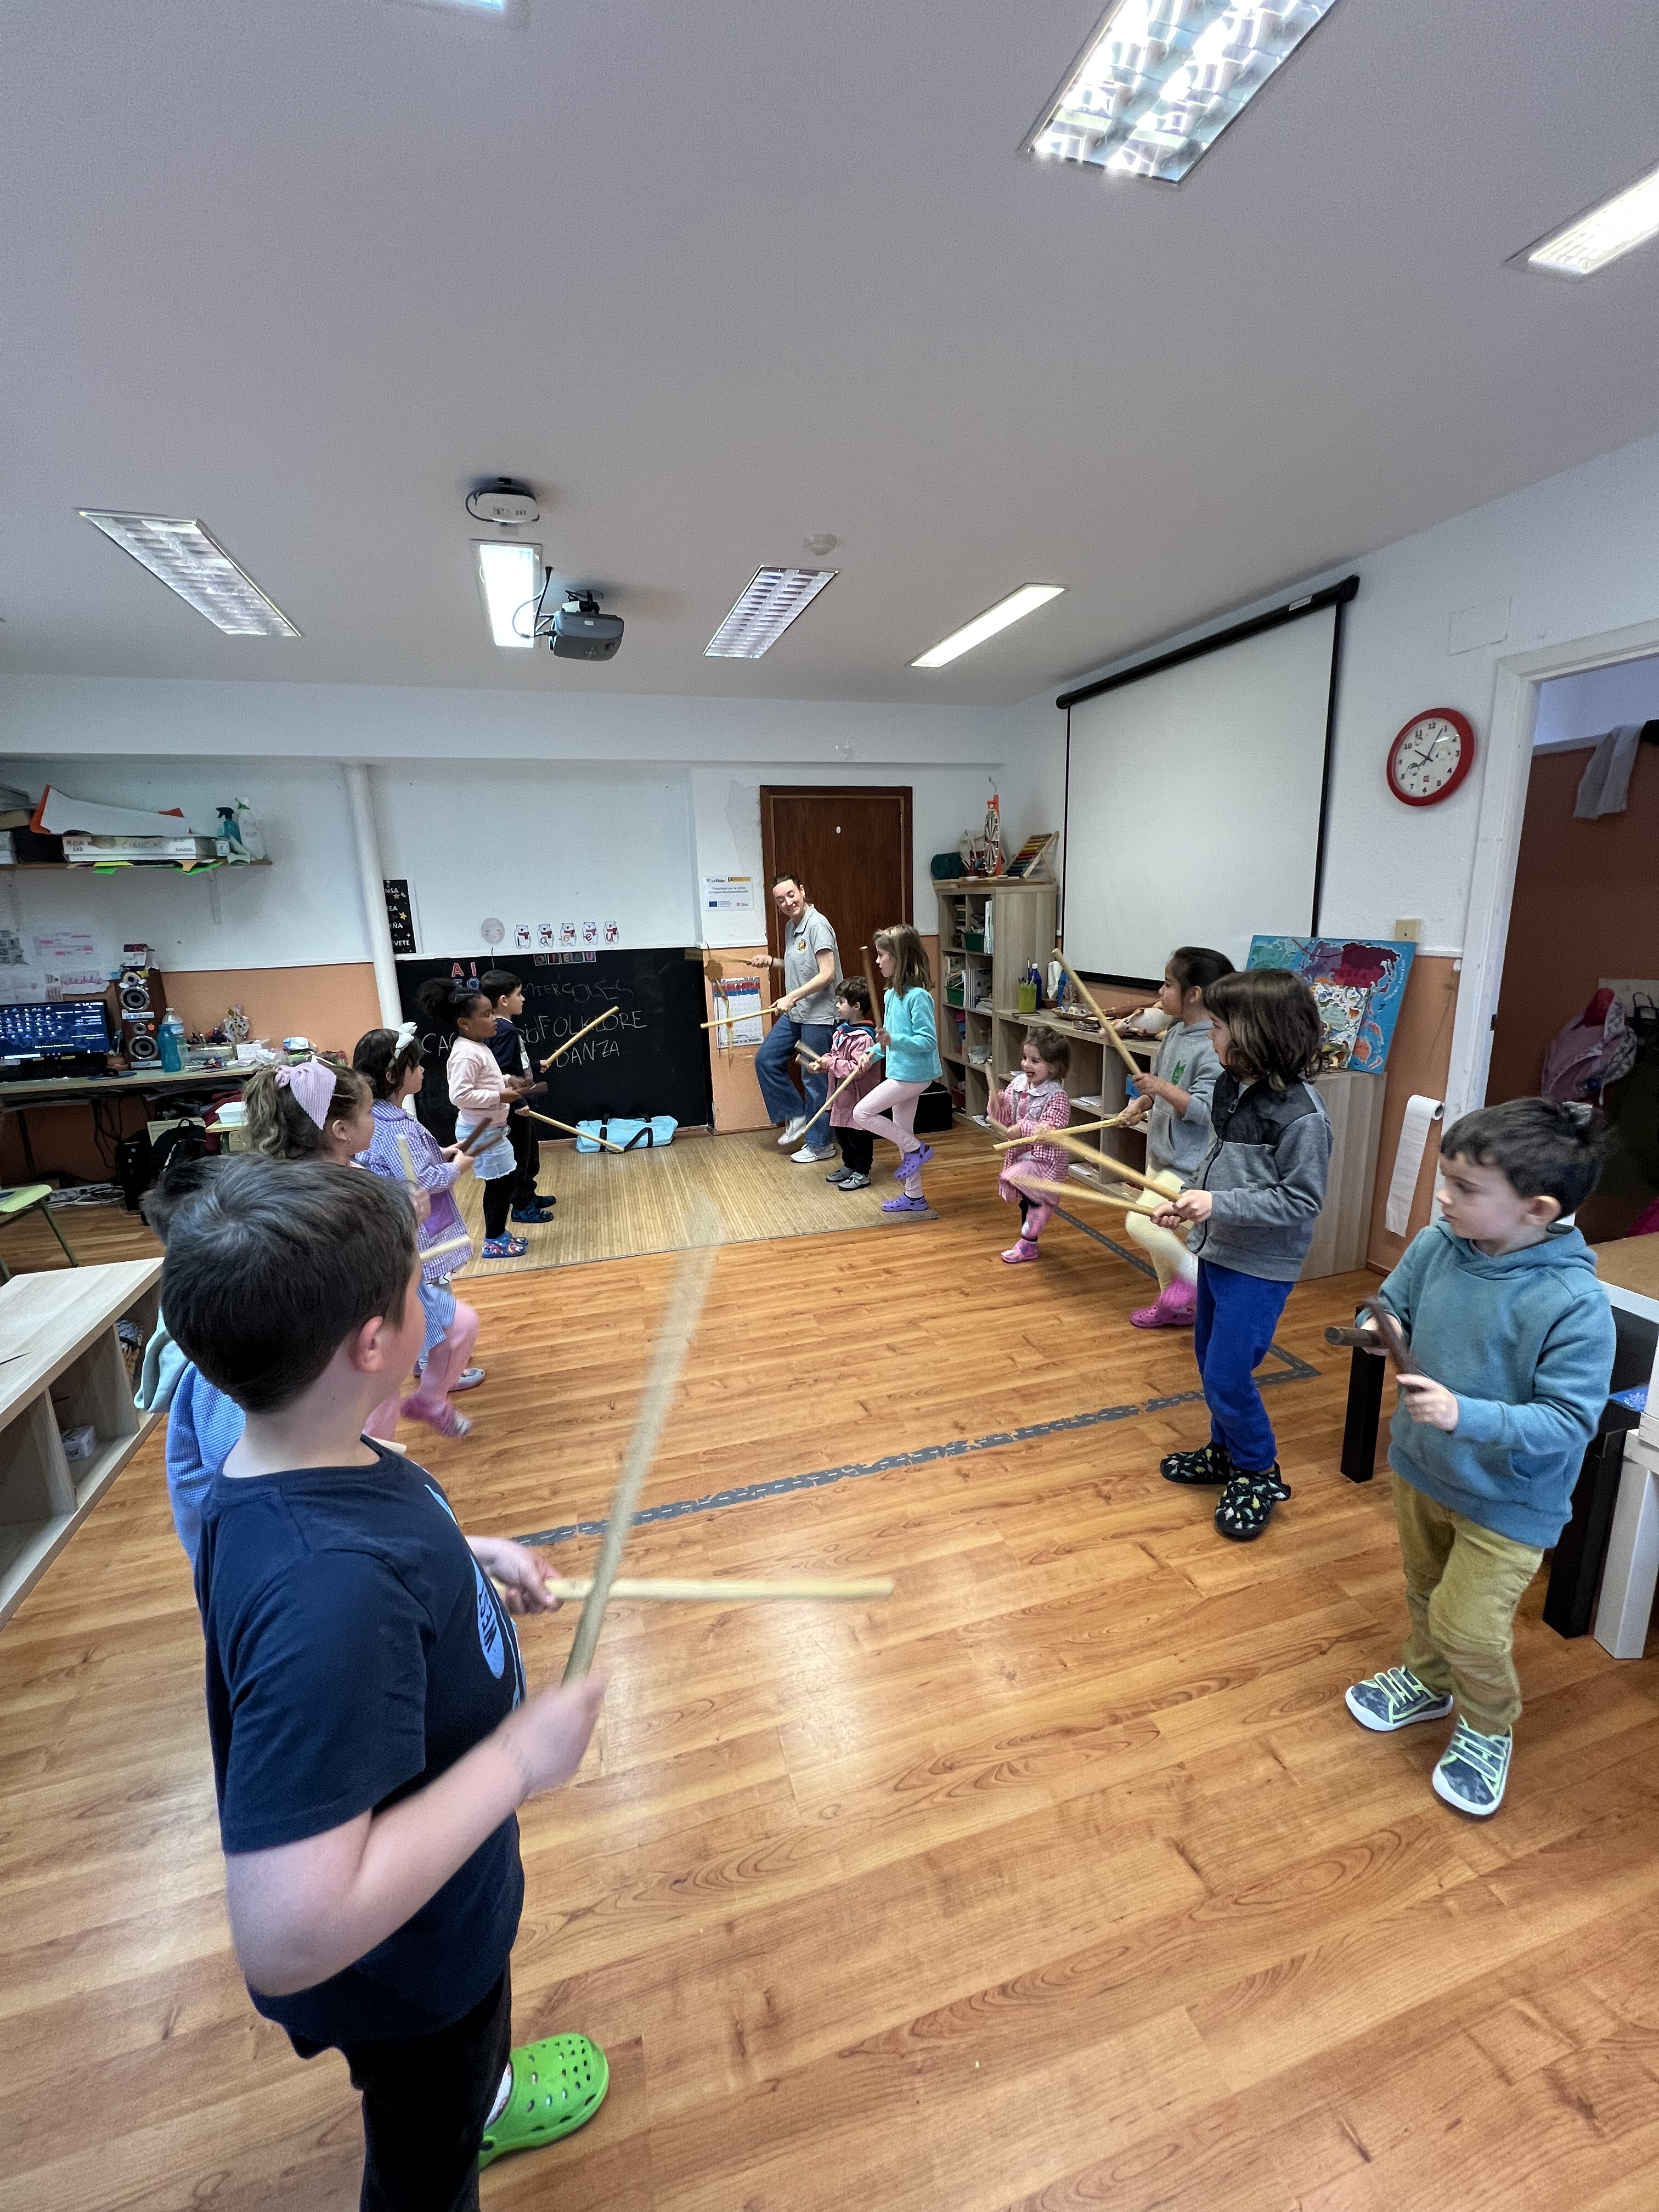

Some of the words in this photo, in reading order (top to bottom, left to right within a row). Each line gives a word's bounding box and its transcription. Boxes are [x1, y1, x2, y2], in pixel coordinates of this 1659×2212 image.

[451, 962, 465, 978] A
[466, 977, 481, 990] O
[554, 1040, 620, 1067] DANZA
